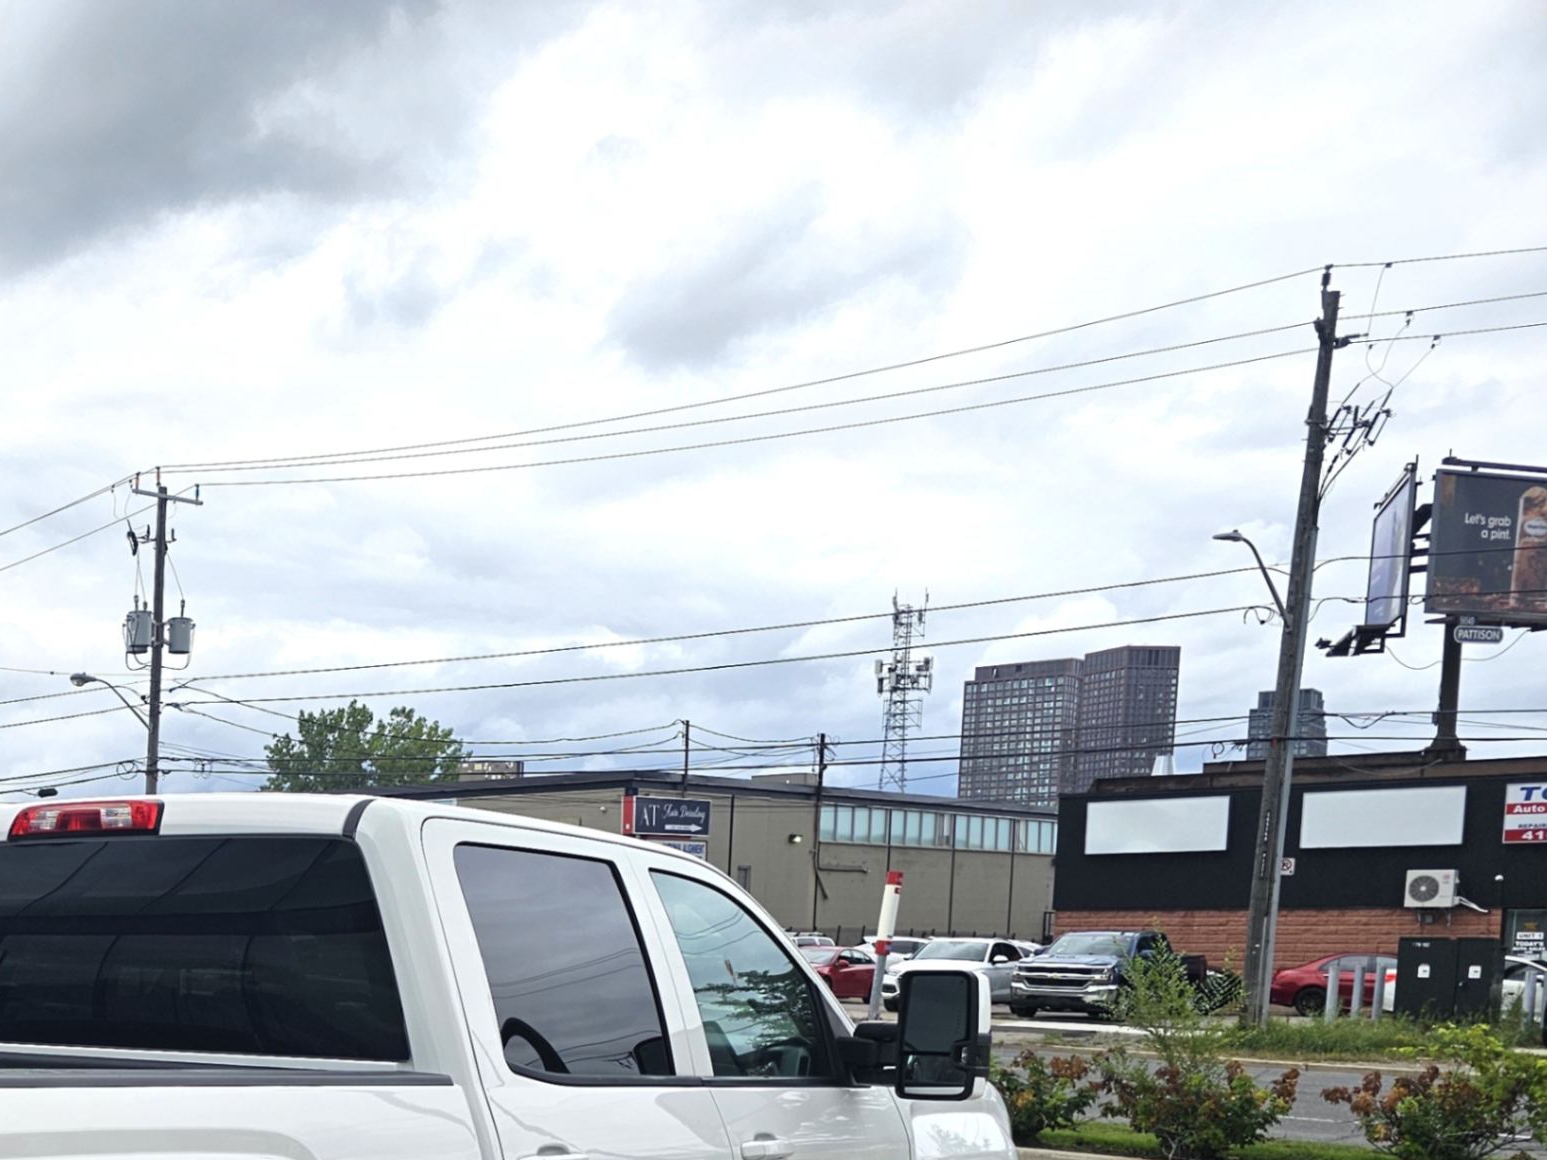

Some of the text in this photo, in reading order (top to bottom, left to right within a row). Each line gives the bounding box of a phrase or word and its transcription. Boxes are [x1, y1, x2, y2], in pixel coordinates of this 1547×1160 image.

[1464, 512, 1486, 525] Let's
[1488, 514, 1512, 529] grab
[1481, 528, 1511, 540] a pint.
[1457, 628, 1500, 641] PATTISON
[1513, 804, 1546, 813] Auto
[1521, 830, 1547, 840] 41
